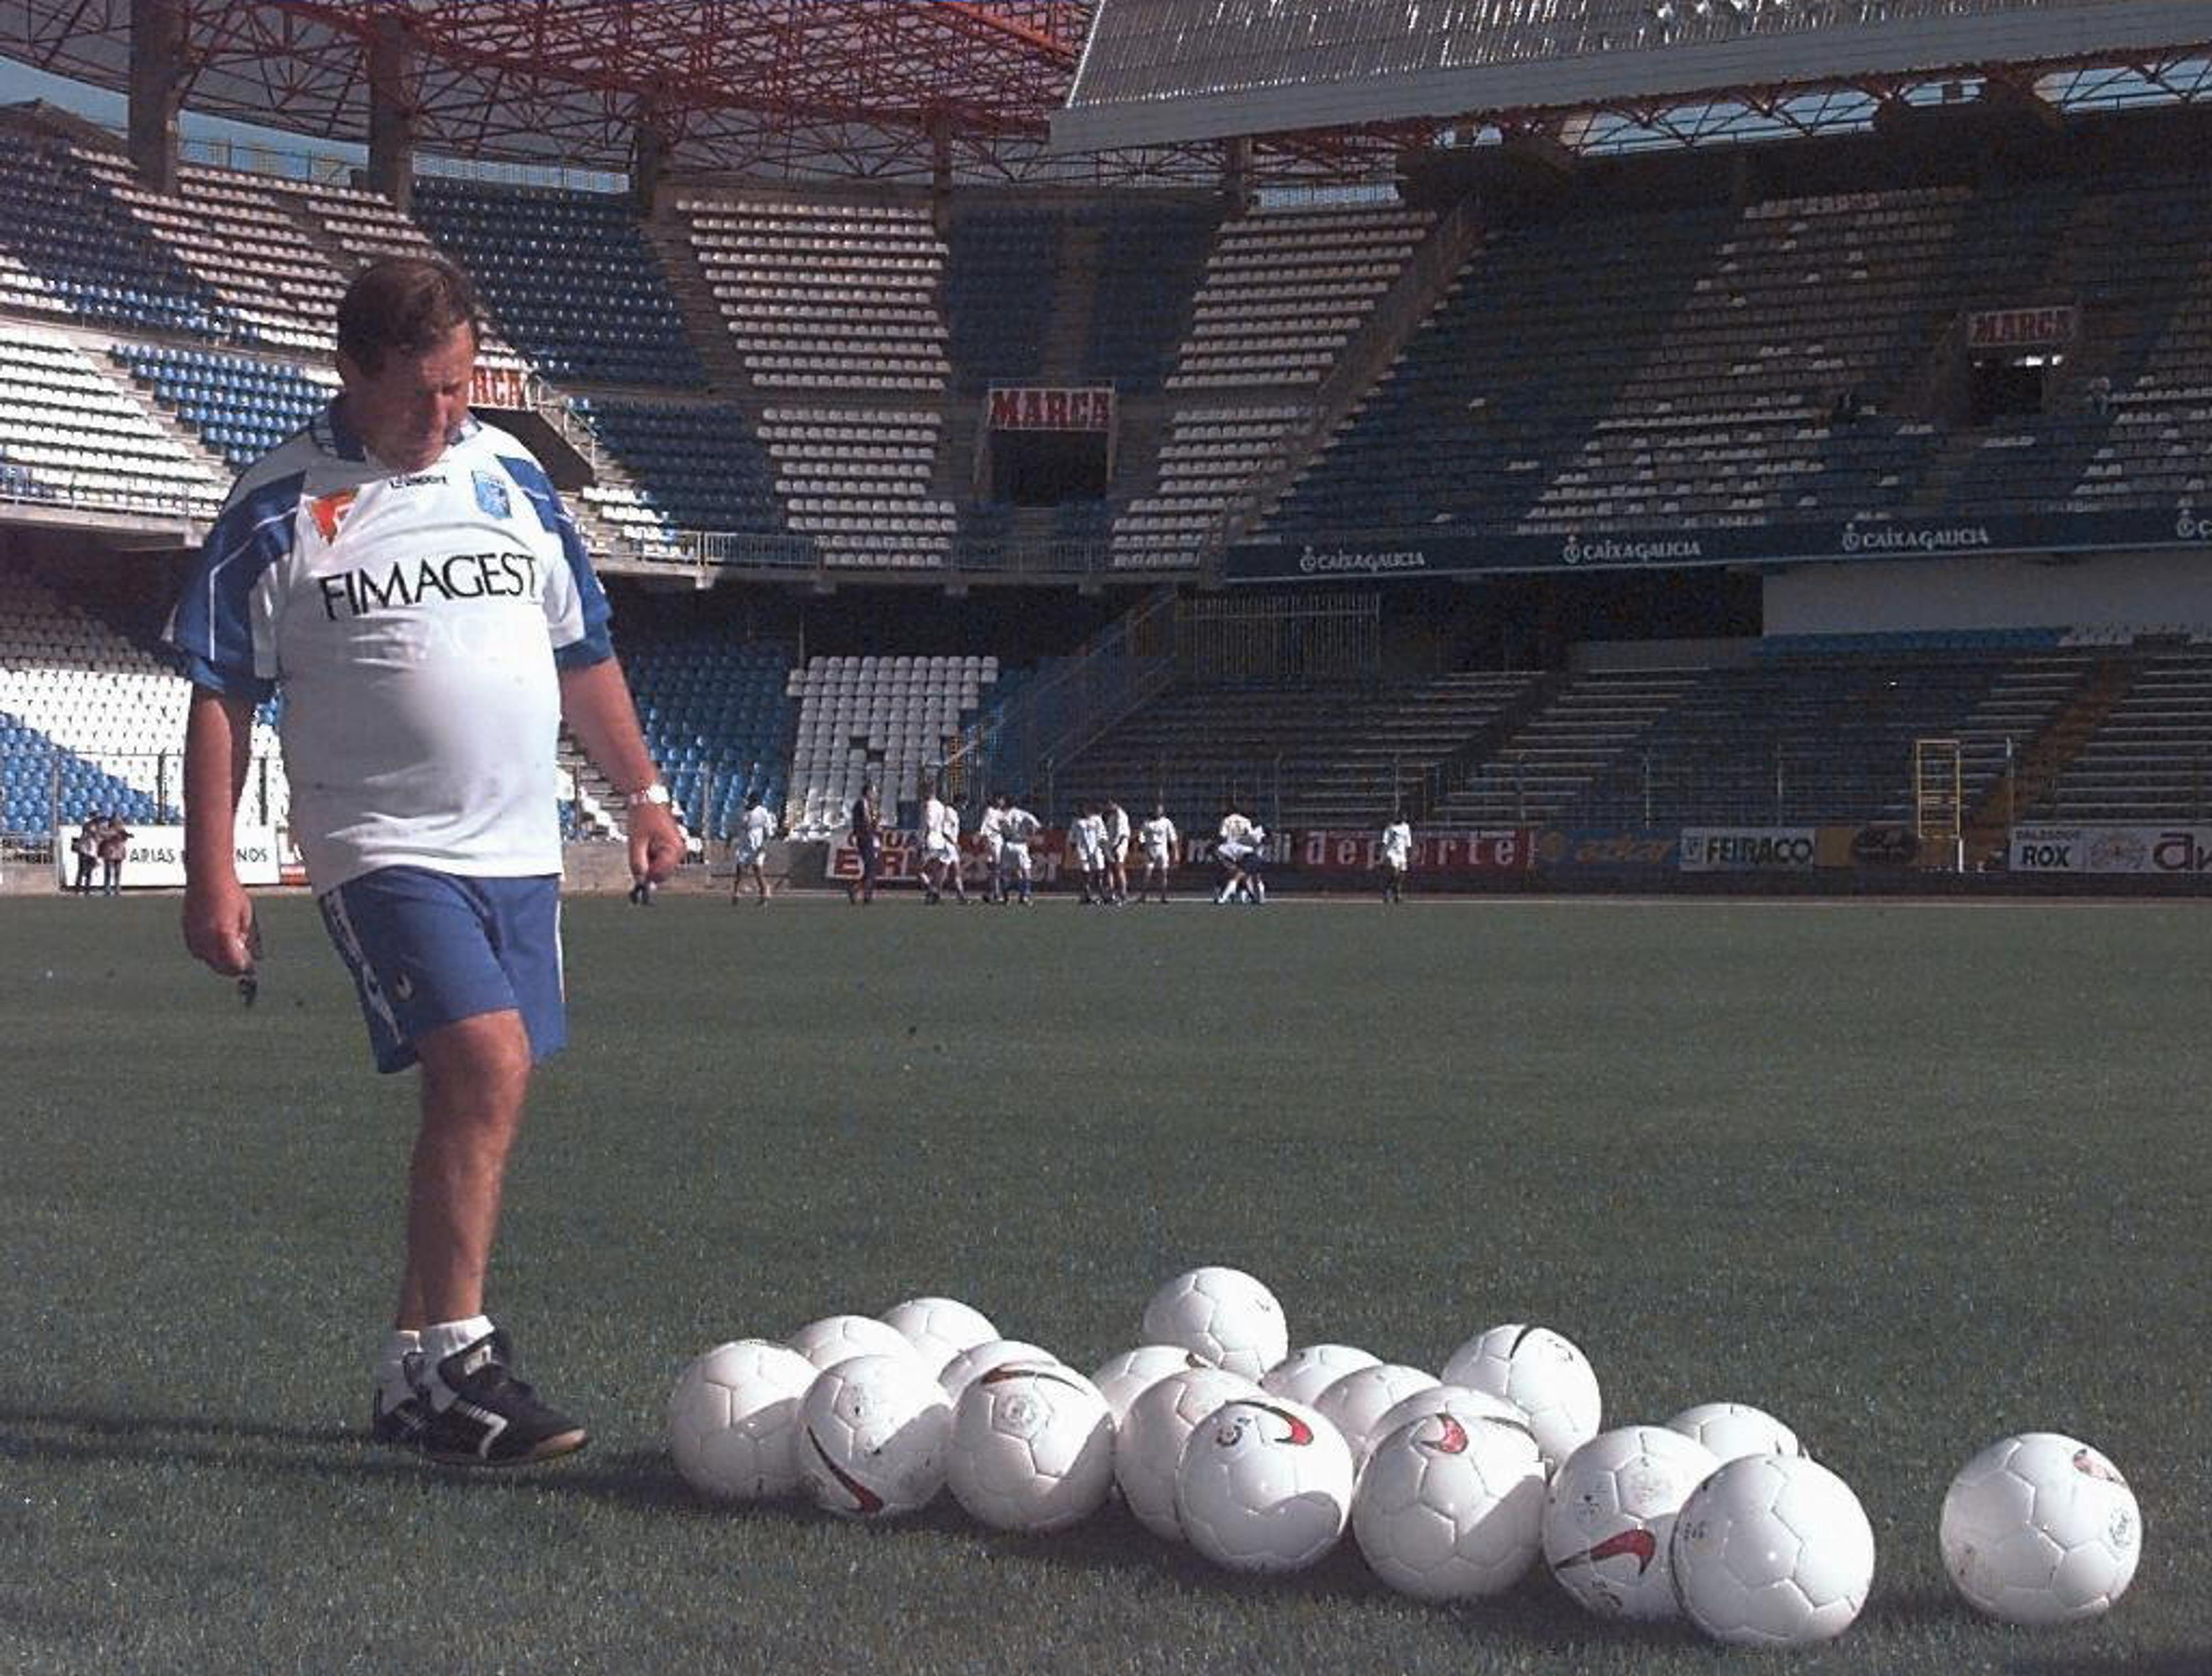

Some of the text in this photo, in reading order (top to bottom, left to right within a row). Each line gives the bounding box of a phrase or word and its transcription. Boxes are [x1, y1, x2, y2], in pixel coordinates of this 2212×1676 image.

[319, 553, 536, 620] FIMAGEST
[1707, 835, 1813, 865] FEIRACO
[2022, 846, 2070, 867] ROX
